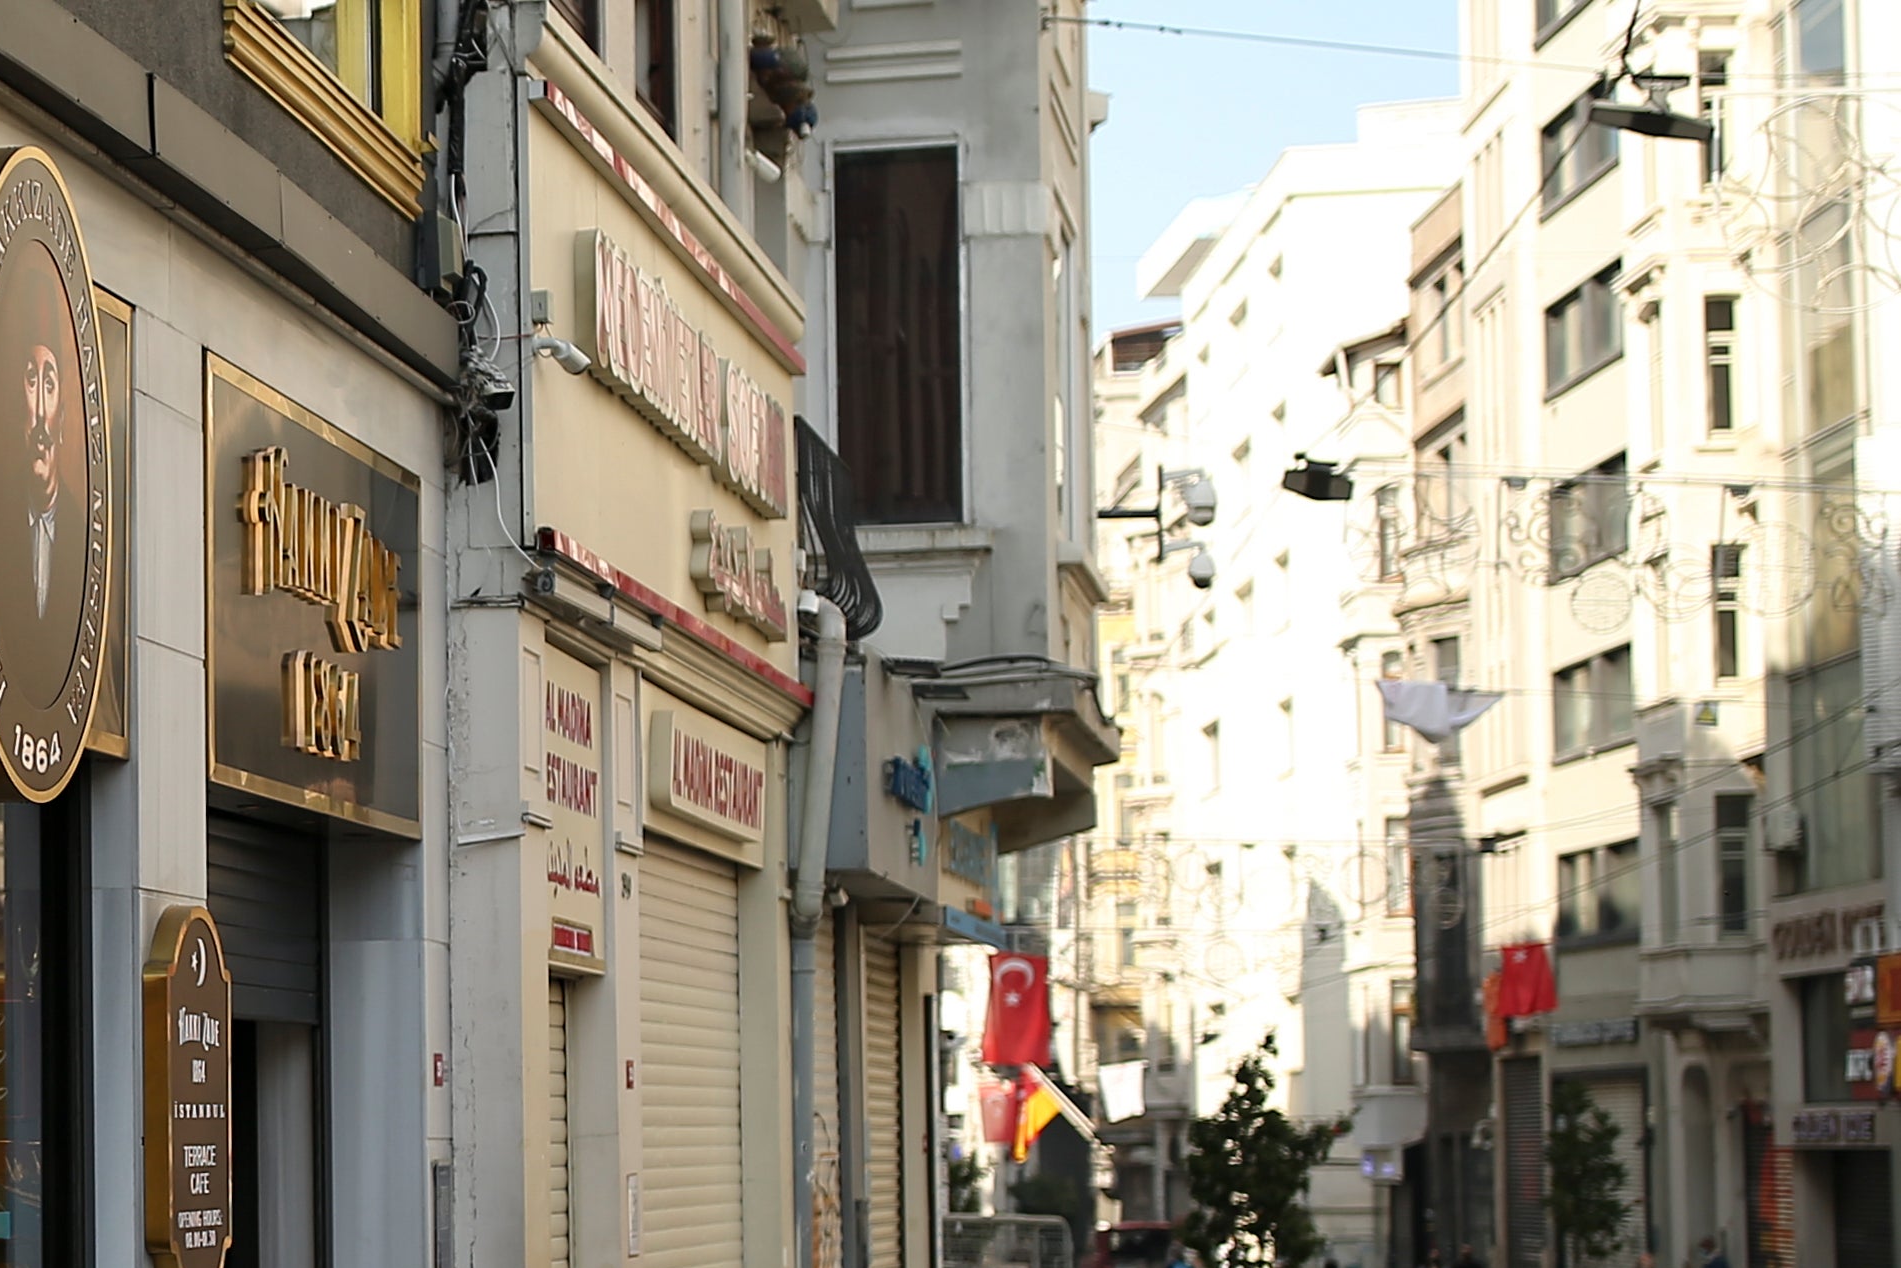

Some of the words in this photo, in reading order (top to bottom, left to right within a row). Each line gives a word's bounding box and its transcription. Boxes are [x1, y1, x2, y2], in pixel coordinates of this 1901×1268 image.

[545, 680, 556, 734] AL
[14, 724, 62, 774] 1864
[546, 751, 598, 819] ESTAURANT
[672, 727, 682, 797] AL
[713, 747, 763, 831] RESTAURANT
[174, 1100, 225, 1119] İSTANBUL
[183, 1145, 217, 1168] TERRACE
[190, 1172, 210, 1195] CAFE
